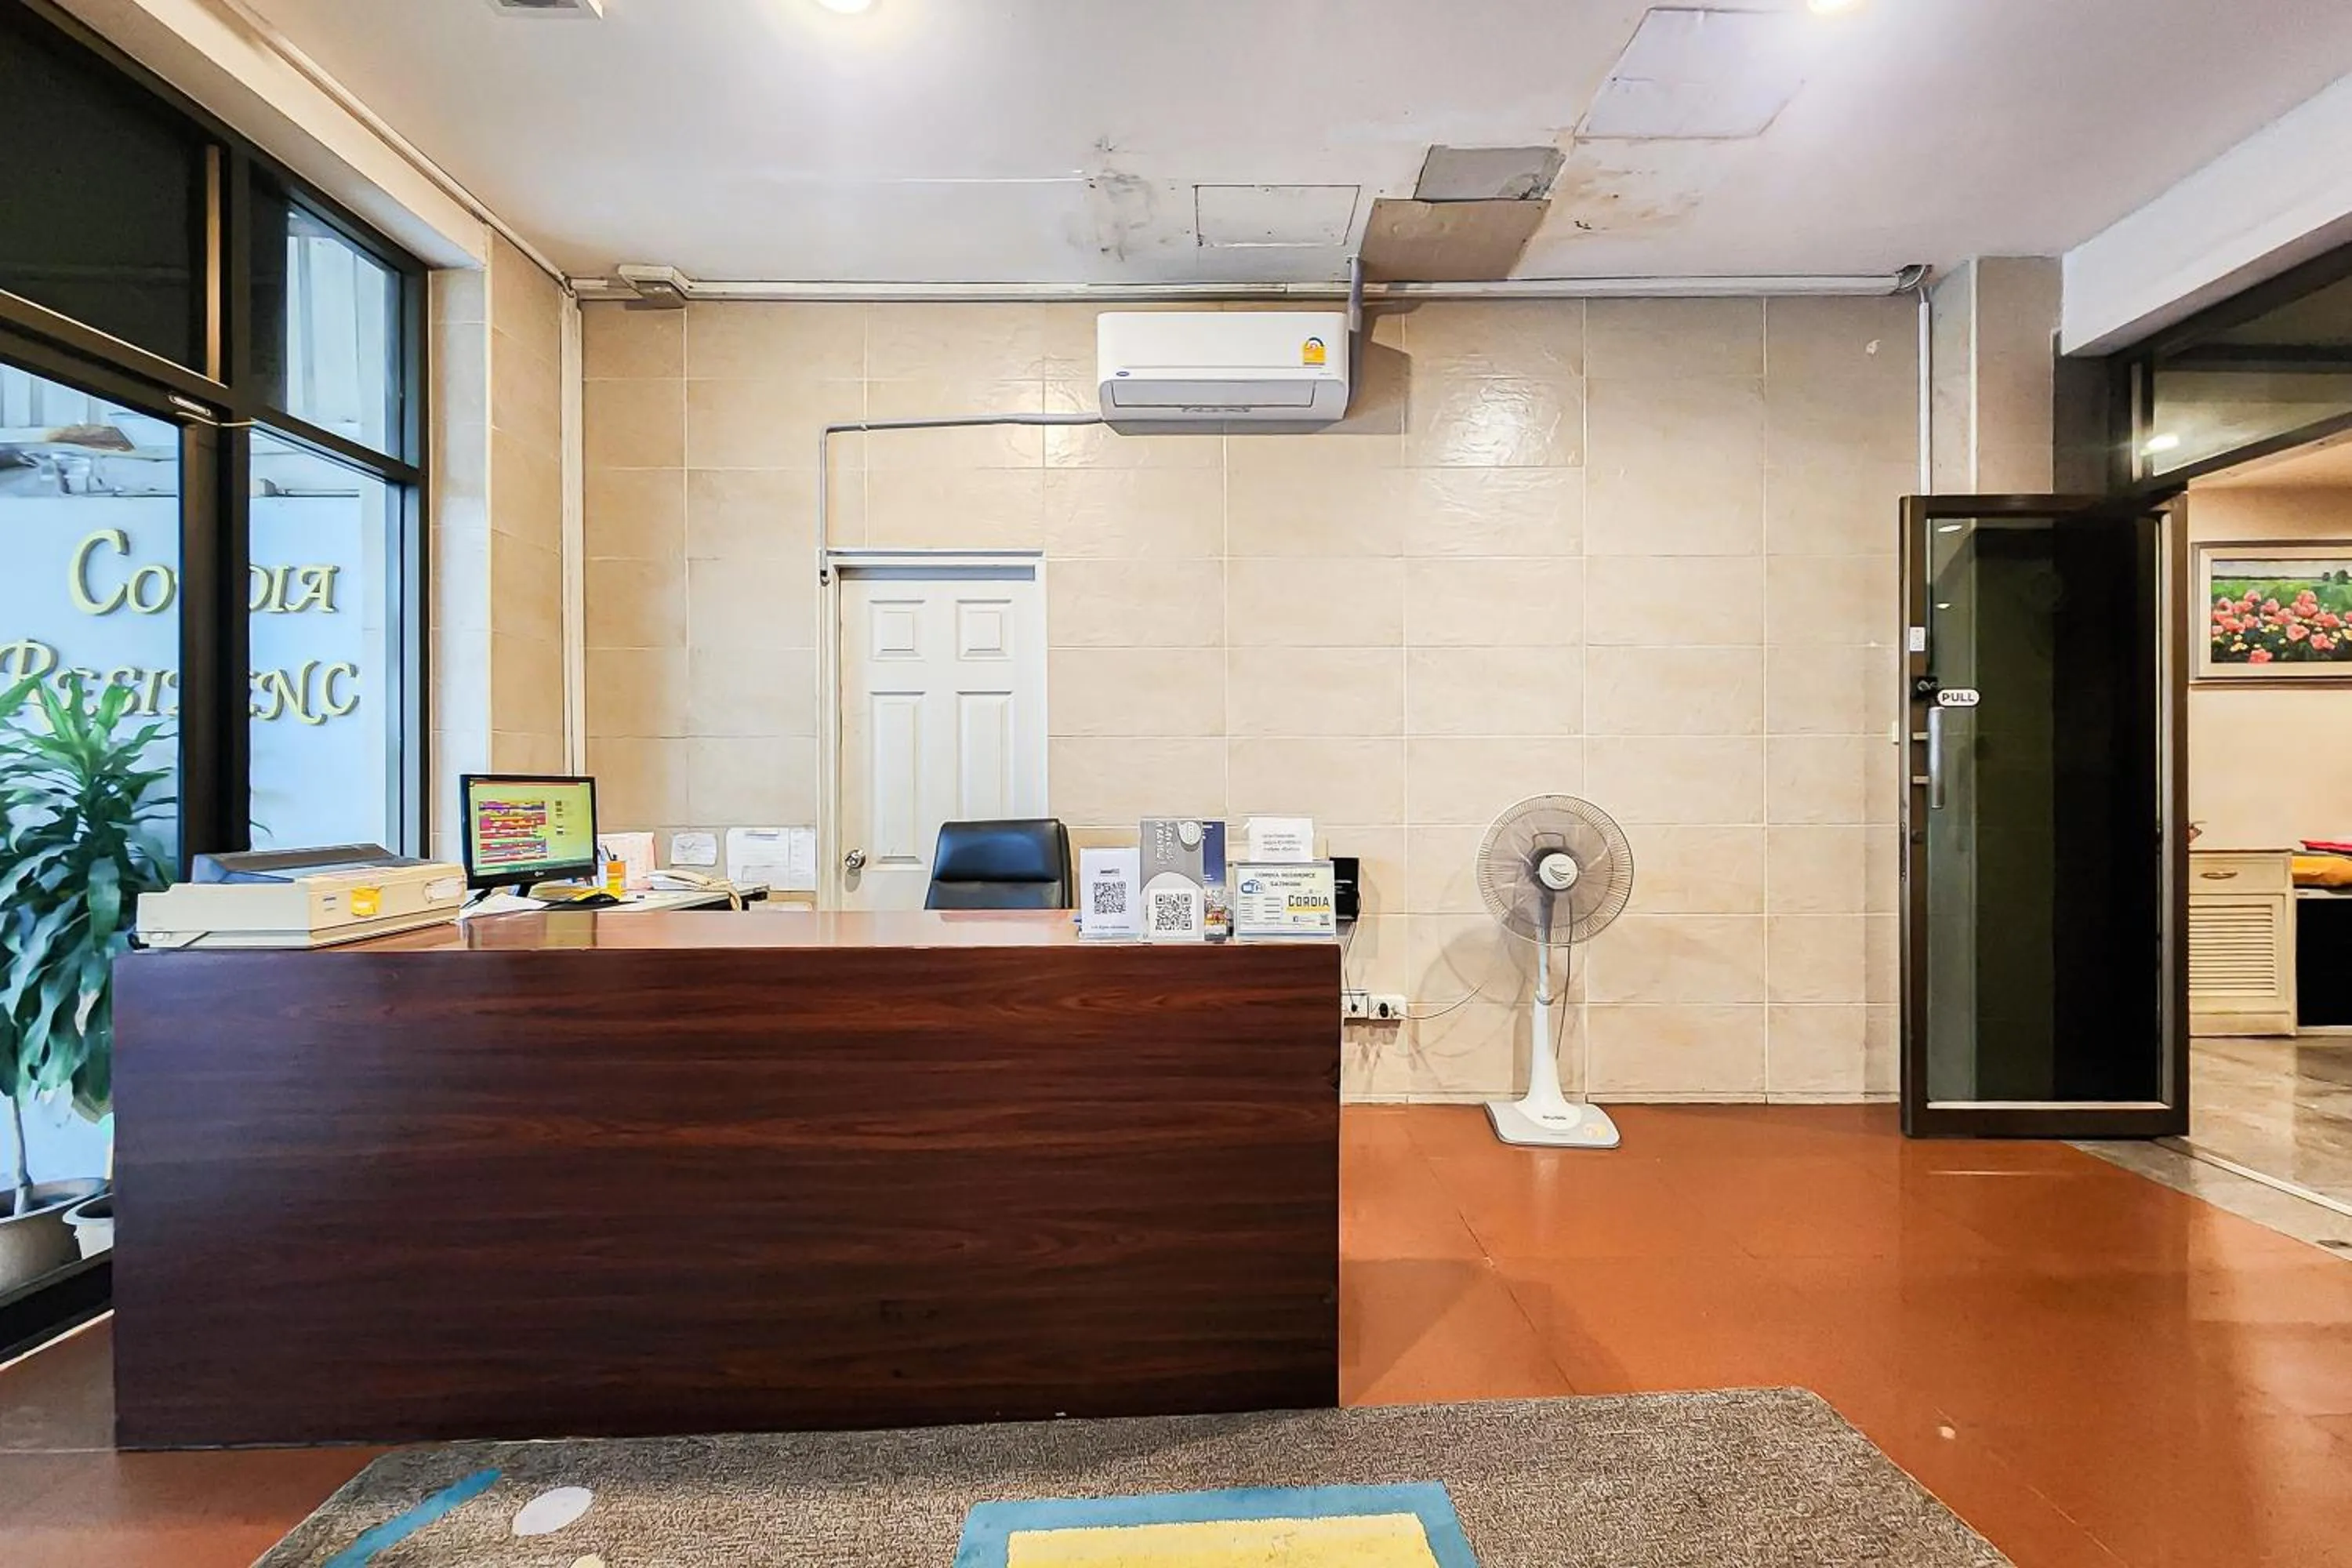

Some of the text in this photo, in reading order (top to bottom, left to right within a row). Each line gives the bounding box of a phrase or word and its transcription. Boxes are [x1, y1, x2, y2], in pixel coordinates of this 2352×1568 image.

[69, 528, 340, 615] CODIA
[1942, 692, 1975, 702] PULL
[1288, 895, 1330, 907] CORDIA
